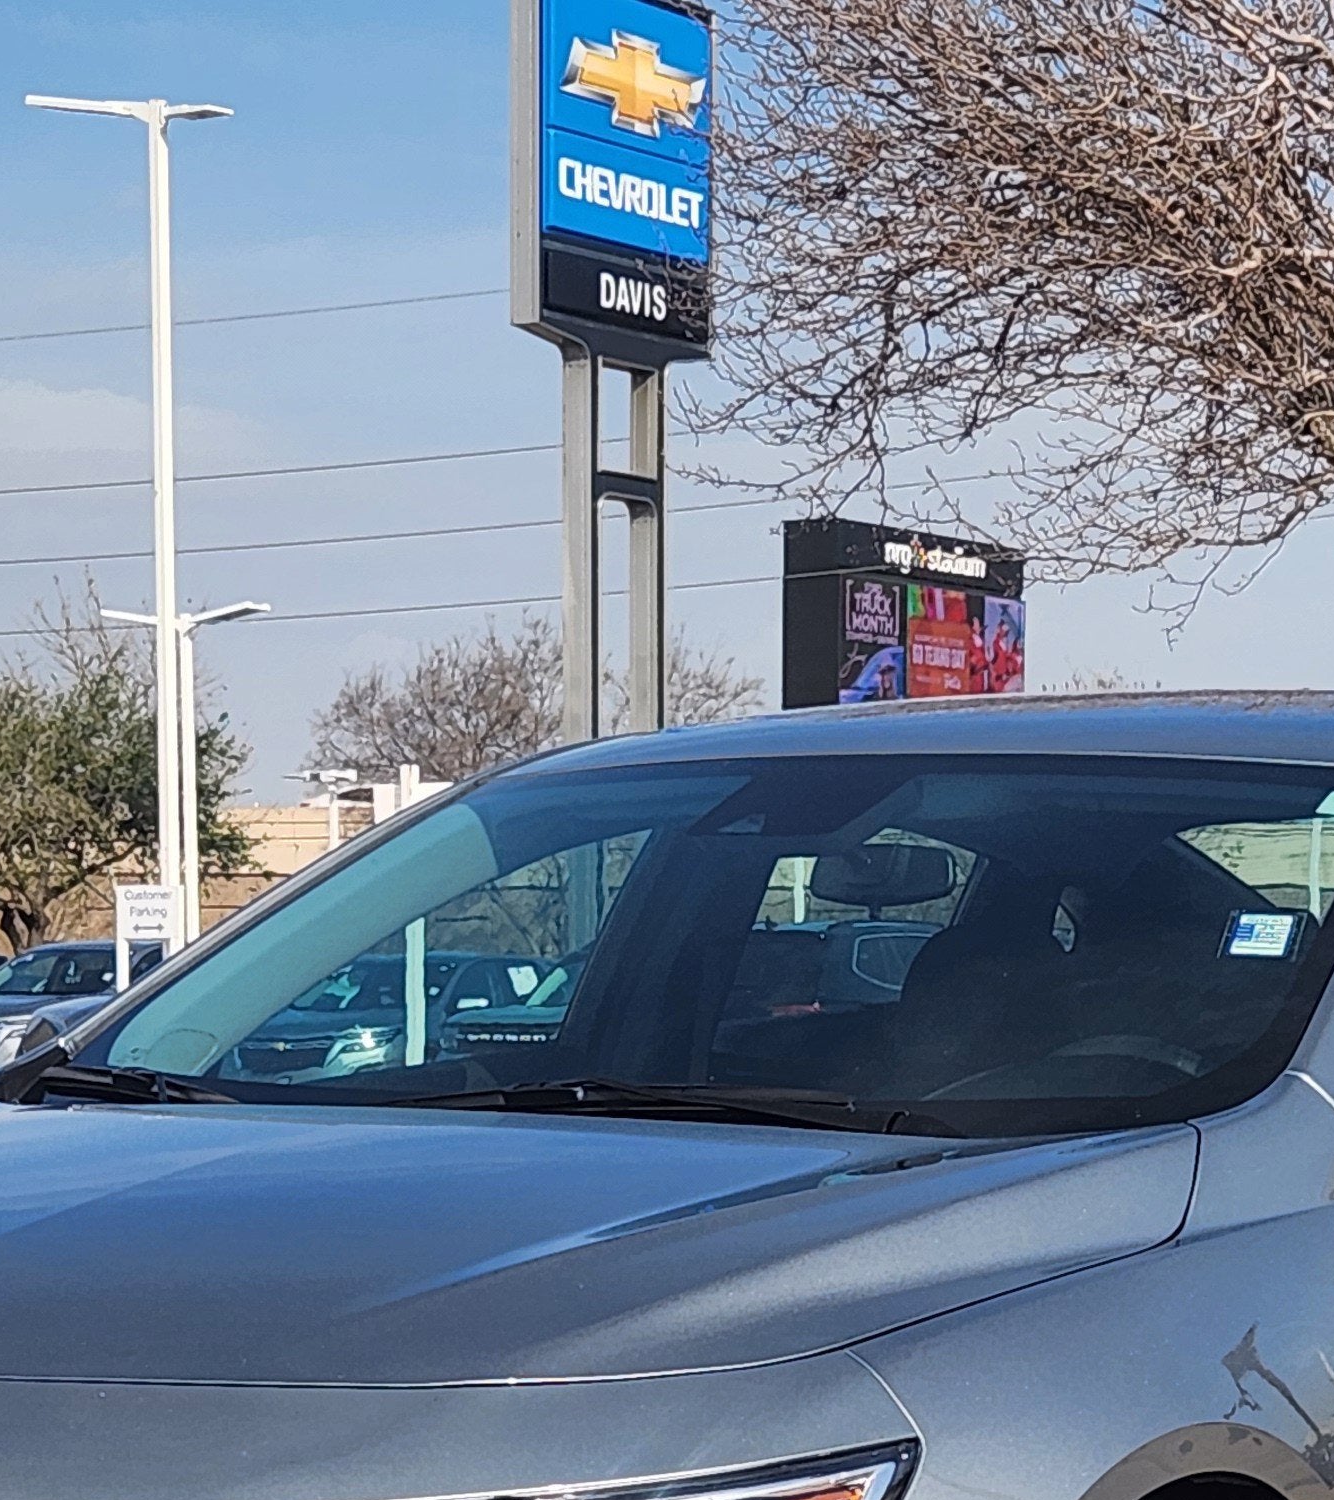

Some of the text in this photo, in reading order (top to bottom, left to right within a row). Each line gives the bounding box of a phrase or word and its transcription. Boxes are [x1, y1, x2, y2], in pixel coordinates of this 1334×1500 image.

[557, 156, 704, 230] CHEVROLET
[600, 271, 667, 322] DAVIS
[854, 590, 892, 616] TRUCK
[851, 611, 894, 635] MONTH
[123, 889, 173, 901] Customer
[129, 906, 168, 918] Parking
